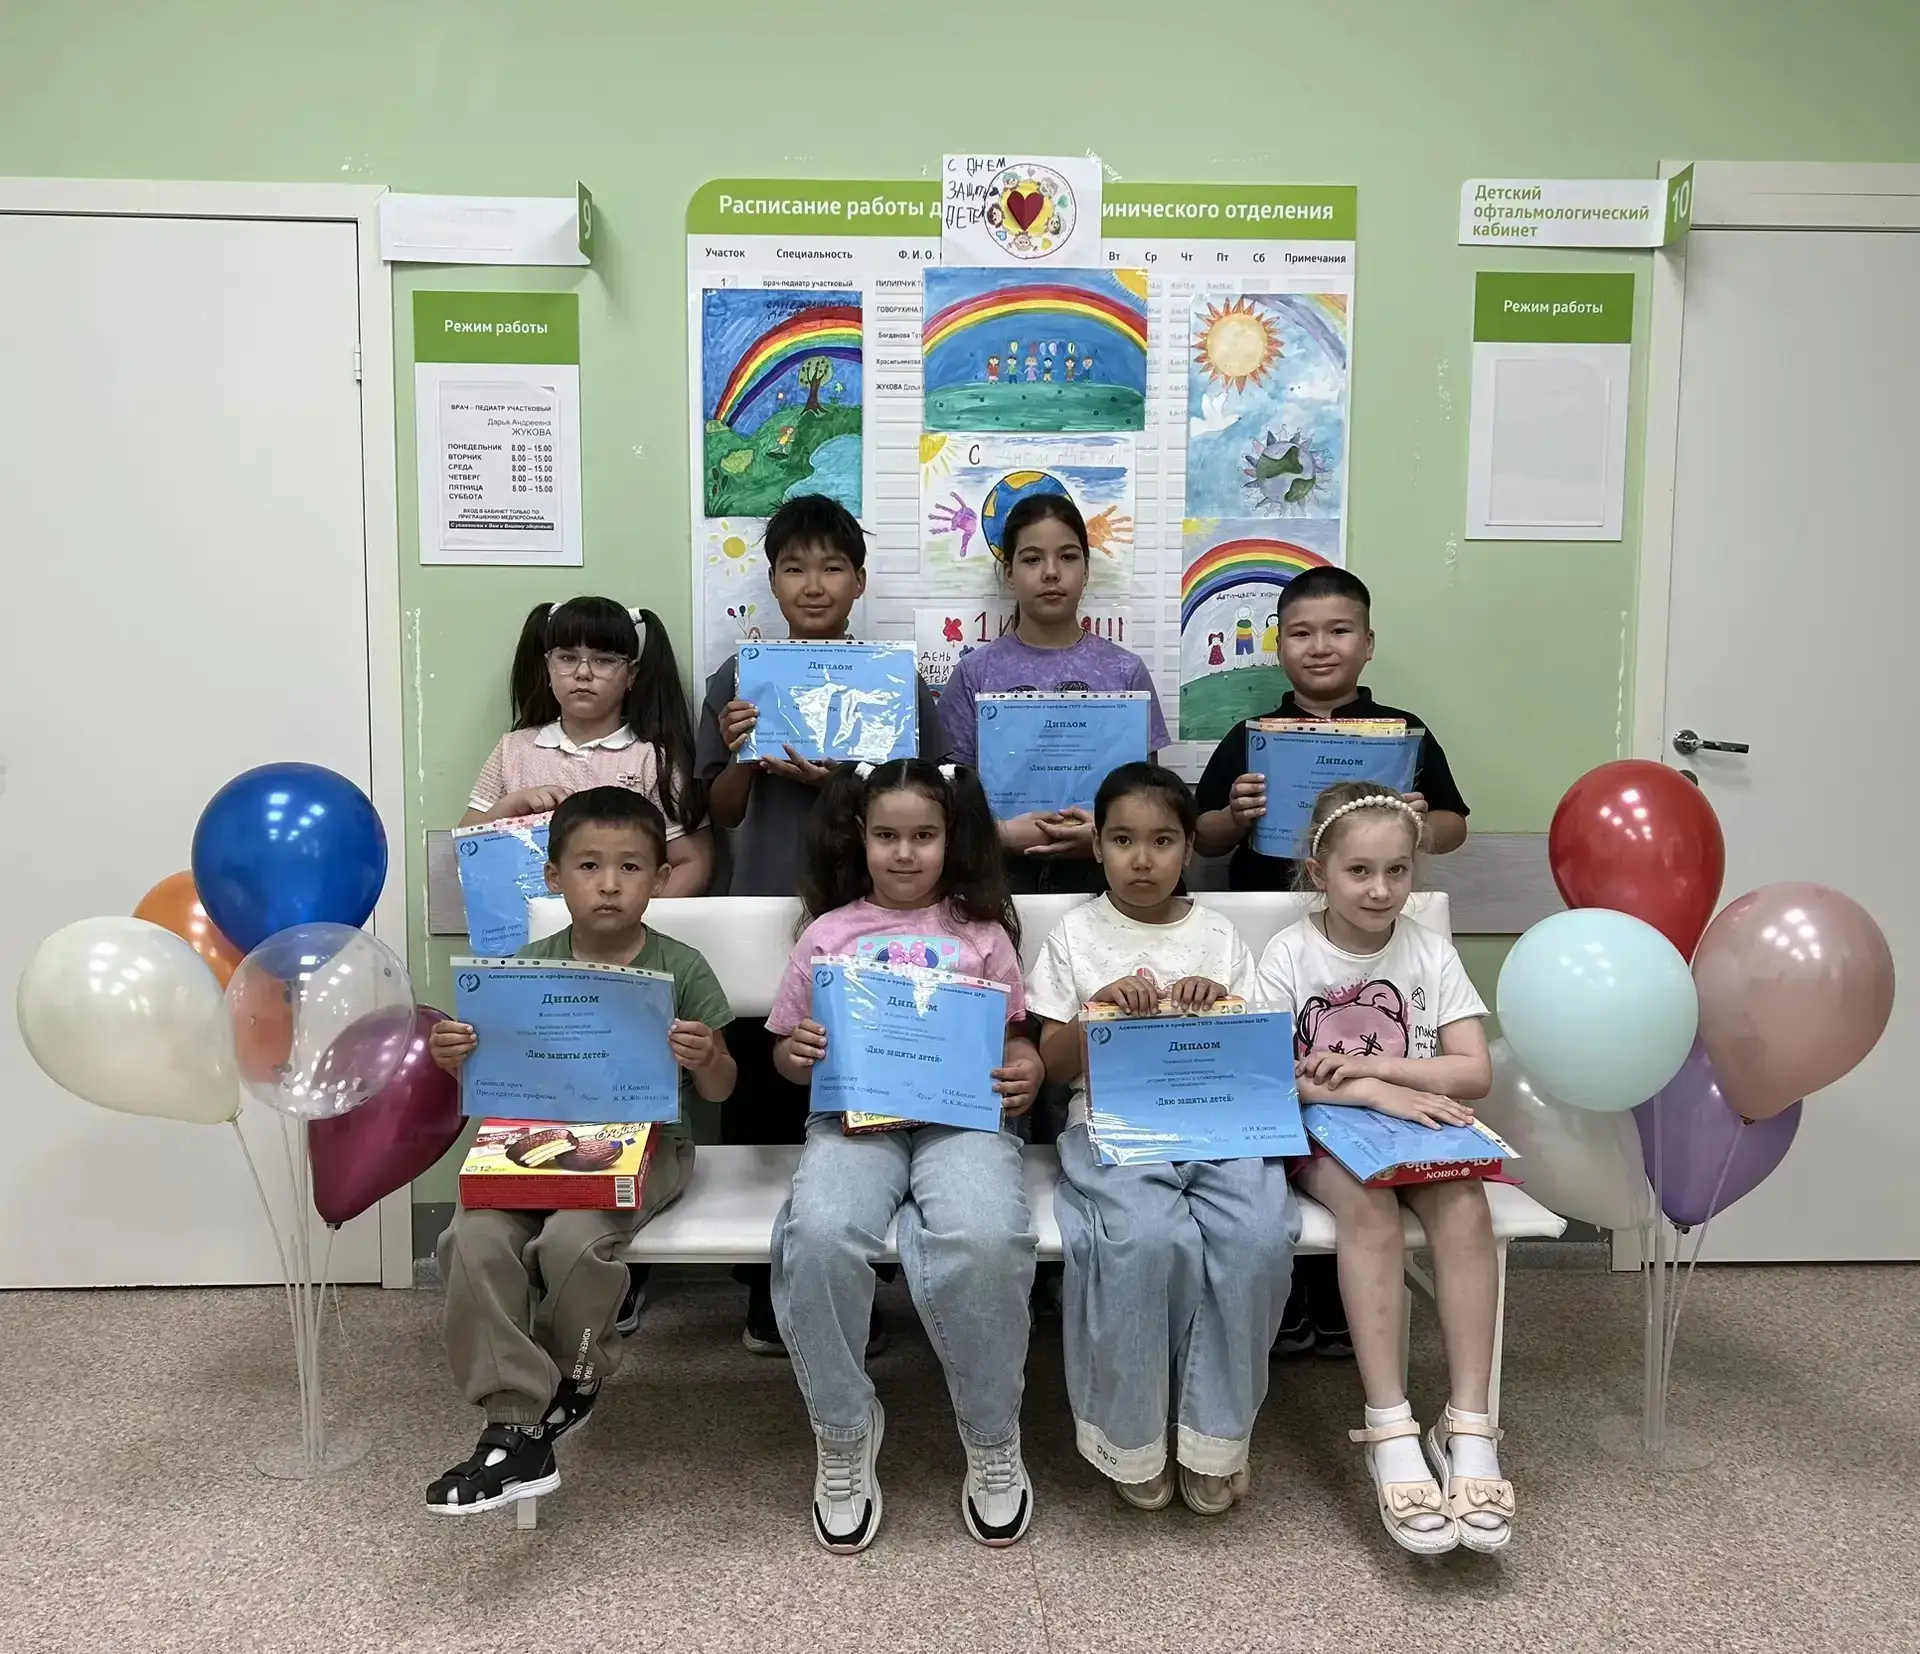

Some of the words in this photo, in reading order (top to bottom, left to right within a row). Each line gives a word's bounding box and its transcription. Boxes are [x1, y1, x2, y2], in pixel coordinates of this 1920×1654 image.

[947, 159, 957, 172] С
[967, 157, 1006, 177] ДНЕМ
[1475, 185, 1541, 200] Детский
[1673, 180, 1689, 223] 10
[719, 195, 841, 214] Расписание
[847, 197, 923, 219] работы
[1102, 203, 1219, 218] инического
[1225, 204, 1333, 221] отделения
[1474, 205, 1649, 221] офтальмологический
[583, 199, 592, 239] 9
[1473, 224, 1537, 237] кабинет
[705, 248, 745, 258] Участок
[776, 249, 853, 260] Специальность
[1109, 252, 1120, 261] Вт
[1144, 252, 1158, 264] Ср
[1181, 253, 1193, 261] Чт
[1217, 253, 1229, 262] Пт
[1253, 253, 1265, 263] Сб
[1284, 254, 1346, 264] Примечания
[721, 278, 727, 287] 1
[763, 280, 810, 288] врач-педиатр
[811, 279, 853, 288] участковый
[1504, 300, 1549, 313] Режим
[1552, 301, 1603, 316] работы
[444, 319, 492, 333] Режим
[496, 321, 548, 336] работы
[487, 418, 510, 426] Дарья
[512, 428, 552, 436] ЖУКОВА
[511, 444, 525, 452] 8.00
[533, 444, 552, 452] 15.00
[512, 454, 526, 462] 8.00
[534, 454, 552, 462] 15.00
[968, 444, 980, 465] С
[513, 485, 527, 493] 8.00
[535, 485, 553, 493] 15.00
[974, 611, 991, 642] 1
[921, 651, 951, 661] ДЕНЬ
[808, 661, 853, 671] Диплом
[918, 662, 957, 676] ЗАЩИТ
[1044, 720, 1087, 729] Диплом
[1316, 756, 1364, 766] Диплом
[541, 994, 599, 1005] Диплом
[1415, 1025, 1437, 1039] Make
[1168, 1041, 1221, 1052] Диплом
[547, 1052, 580, 1060] защиты
[886, 1049, 917, 1060] защиты
[1177, 1097, 1208, 1105] защиты
[863, 1113, 875, 1121] 12
[595, 1124, 646, 1141] Original
[479, 1165, 491, 1173] 12
[1426, 1168, 1458, 1180] ORION
